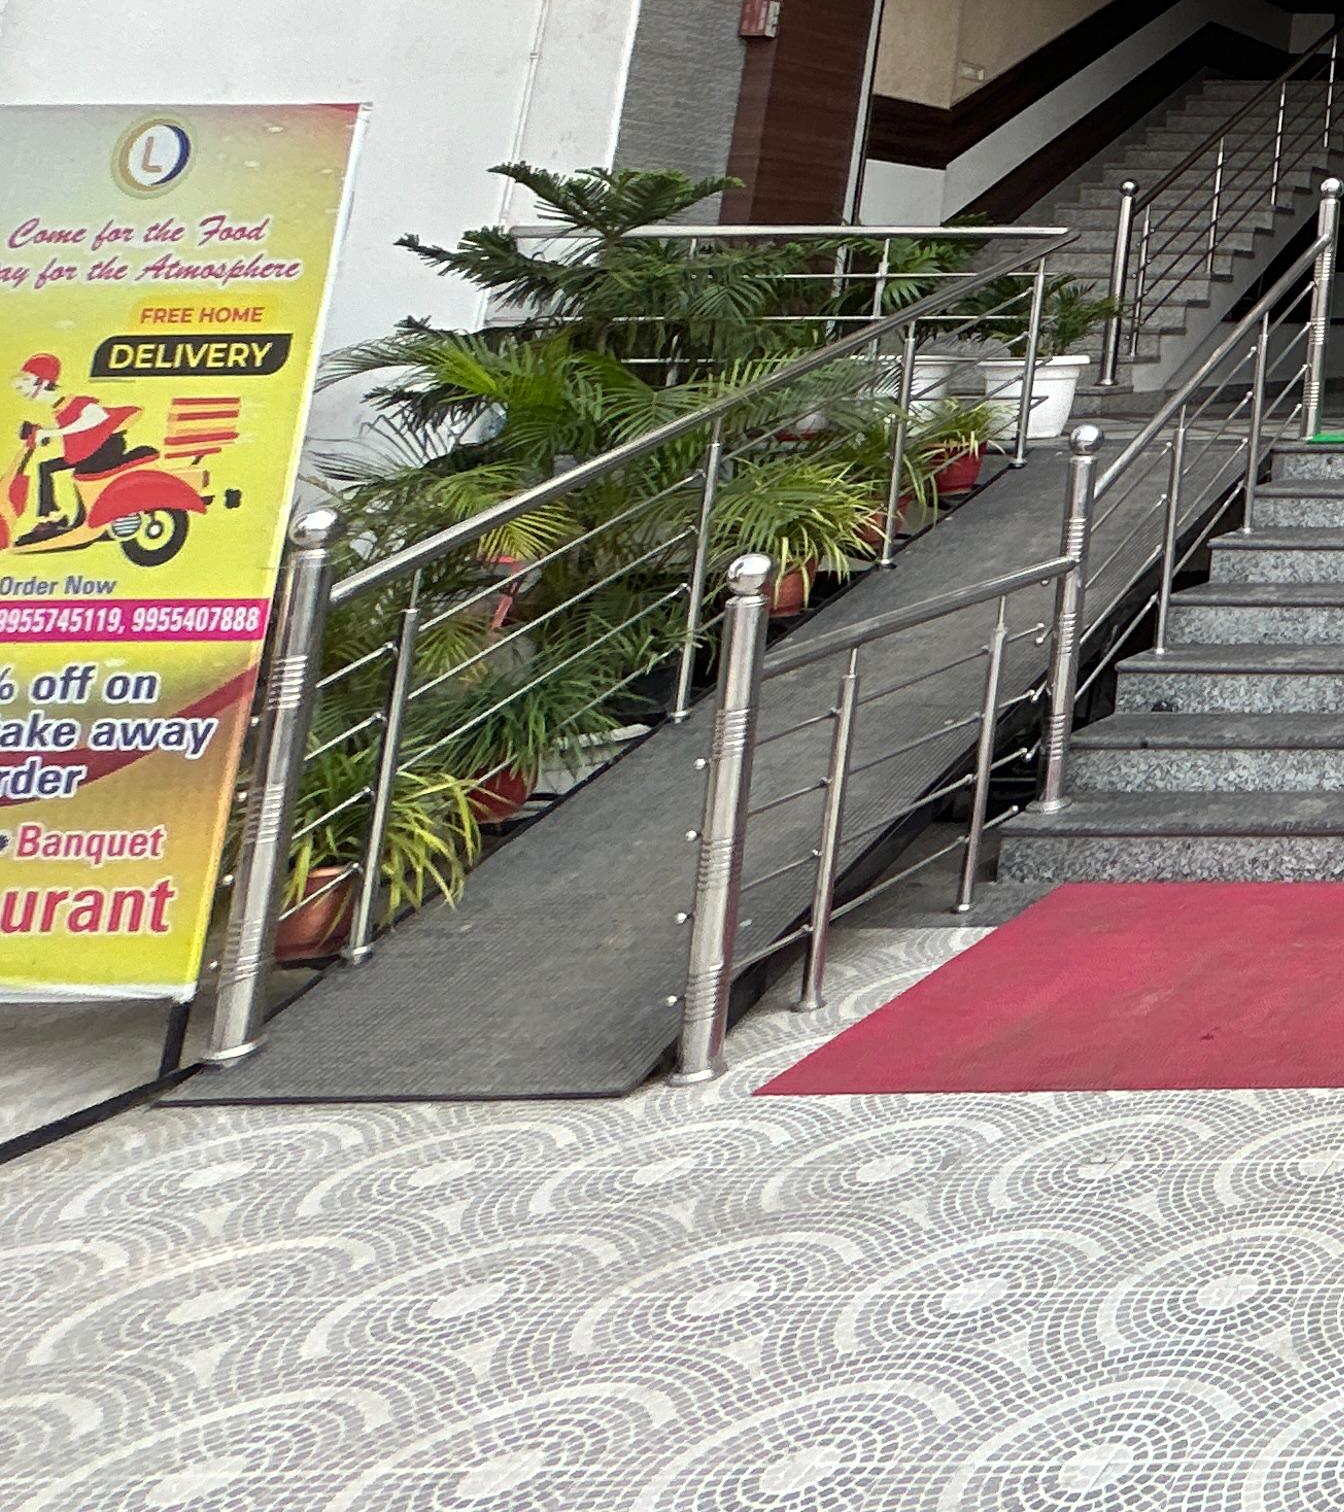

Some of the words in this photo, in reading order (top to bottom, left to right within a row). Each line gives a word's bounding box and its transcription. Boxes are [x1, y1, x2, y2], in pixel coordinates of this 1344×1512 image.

[8, 217, 88, 249] Come
[91, 219, 134, 251] for
[143, 218, 184, 244] the
[197, 214, 270, 246] Food
[0, 266, 30, 289] ay
[34, 257, 77, 289] for
[87, 255, 129, 281] the
[135, 253, 302, 286] Atmosphere
[140, 307, 192, 324] FREE
[199, 306, 264, 323] HOME
[108, 343, 273, 370] DELIVERY
[0, 576, 59, 596] Order
[65, 575, 117, 595] Now
[131, 605, 260, 632] 9955407888
[32, 665, 97, 701] off
[105, 675, 158, 701] on
[0, 713, 77, 748] ake
[92, 720, 213, 755] away
[0, 760, 83, 795] rder
[17, 825, 164, 865] Banquet
[1, 879, 175, 933] urant
